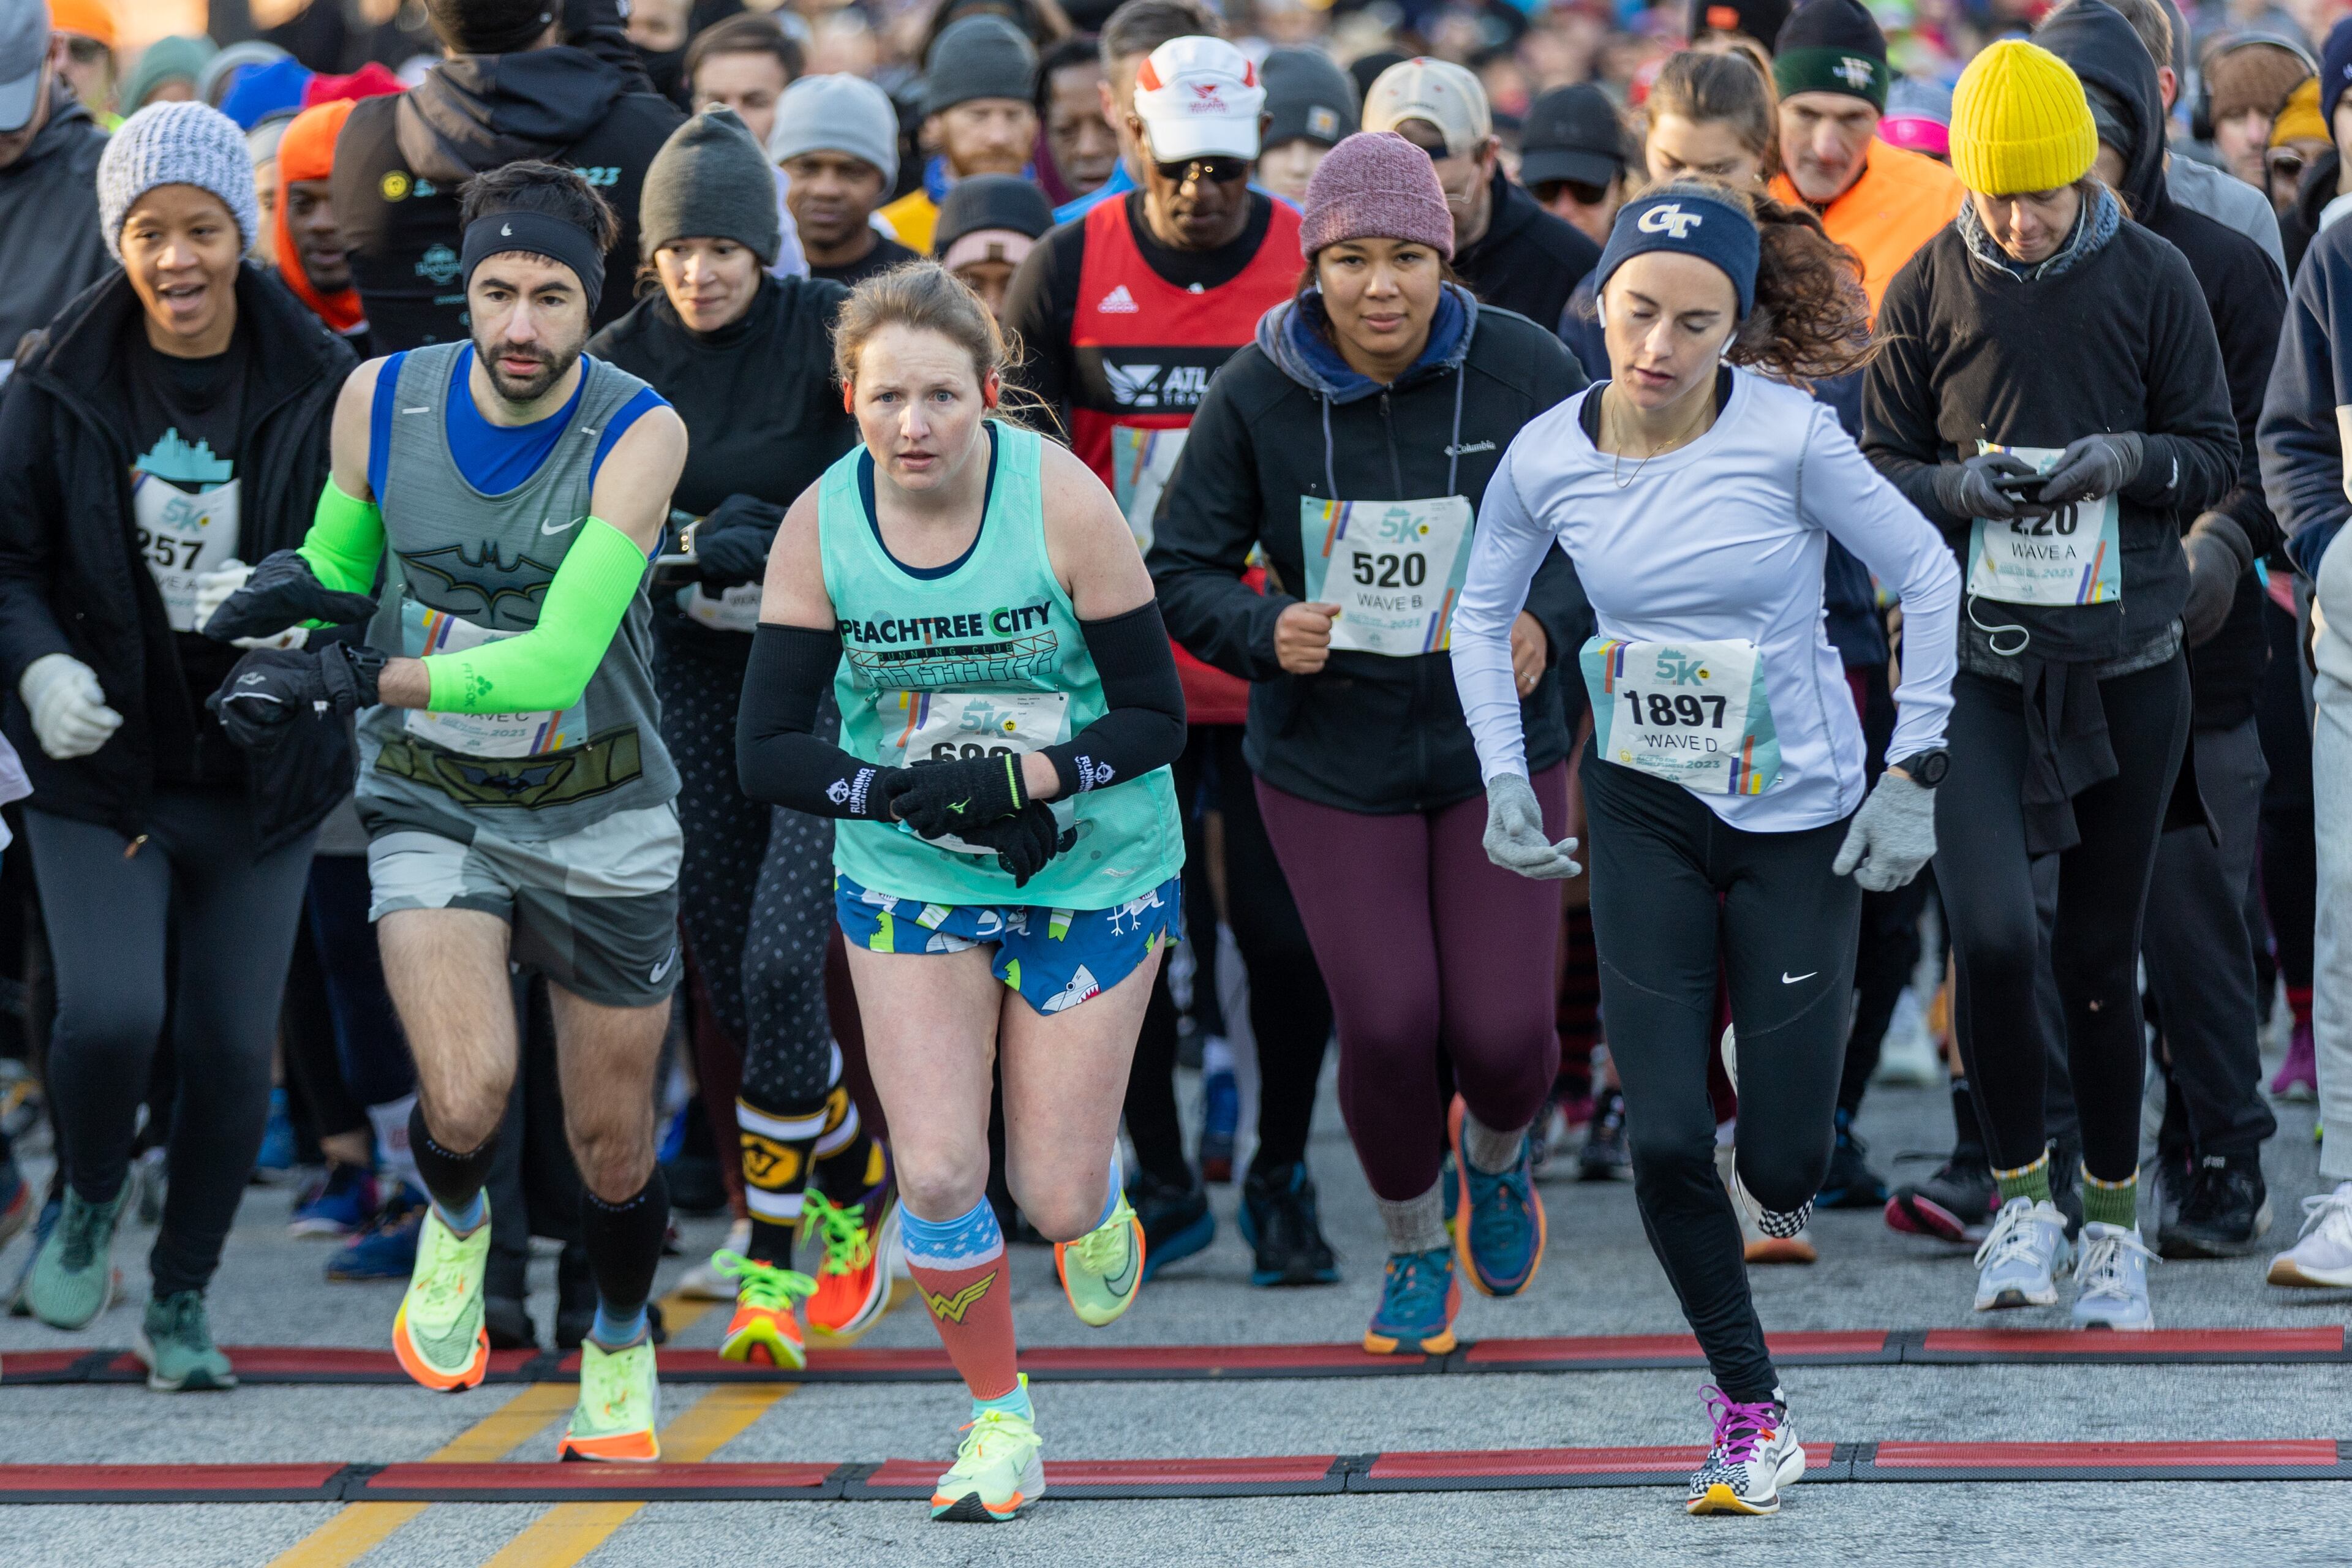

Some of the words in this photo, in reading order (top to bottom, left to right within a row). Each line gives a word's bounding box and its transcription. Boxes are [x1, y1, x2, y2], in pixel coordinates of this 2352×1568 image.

[1638, 203, 1703, 239] GT
[1163, 366, 1210, 393] ATL
[1455, 440, 1496, 454] Columbia
[1378, 515, 1425, 543] 5K
[2011, 541, 2059, 560] WAVE
[2065, 544, 2077, 559] A
[1352, 552, 1426, 588] 520
[1357, 592, 1406, 611] WAVE
[1411, 595, 1423, 608] B
[840, 617, 984, 644] PEACHTREE
[989, 600, 1052, 638] CITY
[878, 647, 956, 661] RUNNING
[973, 643, 1014, 655] CLUB
[1655, 660, 1705, 687] 5K
[1623, 690, 1727, 729] 1897
[959, 710, 1012, 738] 5K
[1645, 734, 1701, 750] WAVE
[1706, 738, 1717, 752] D
[1685, 760, 1721, 769] 2023
[850, 767, 870, 813] RUNNING
